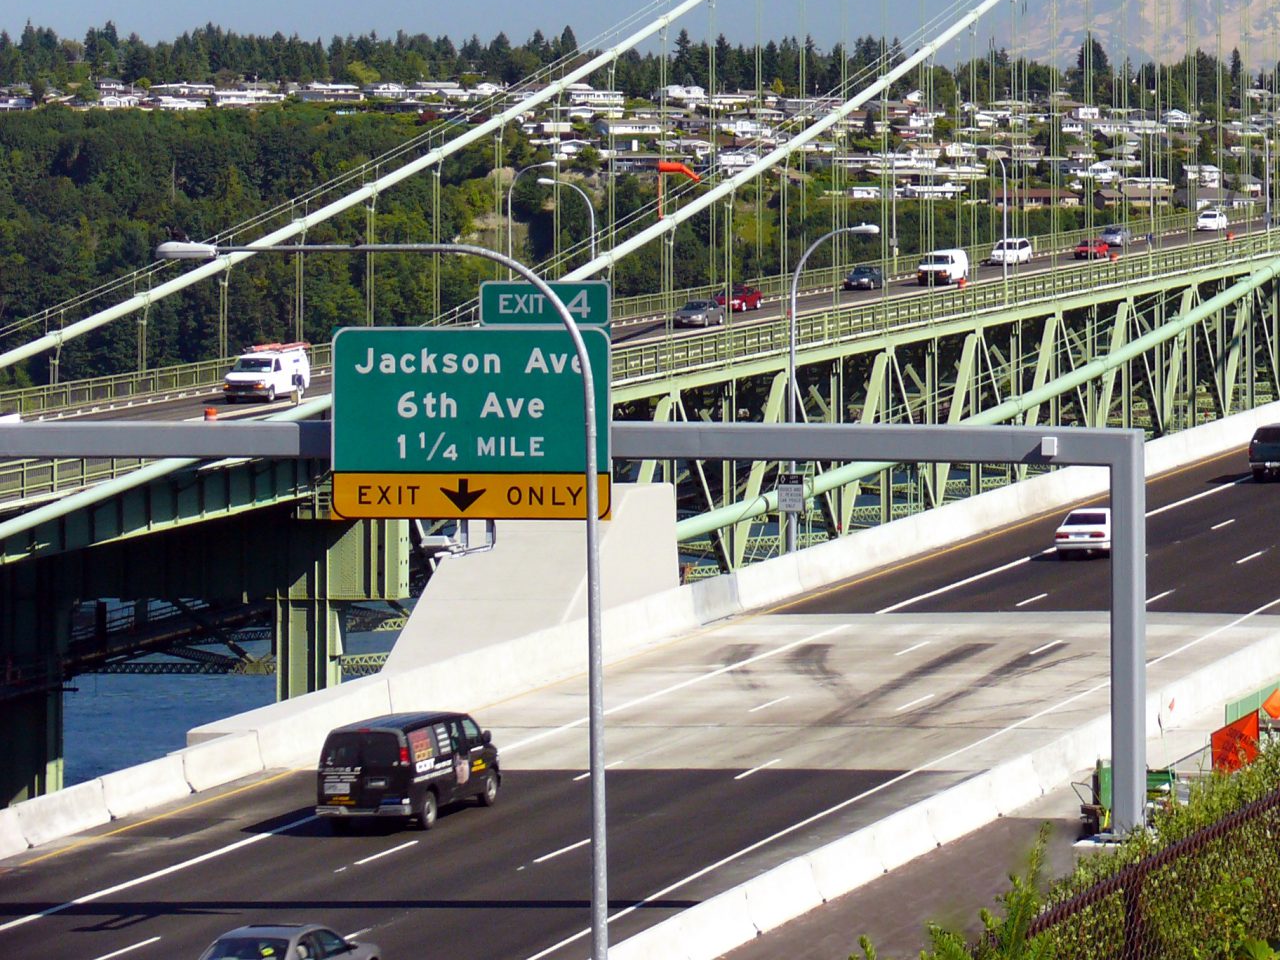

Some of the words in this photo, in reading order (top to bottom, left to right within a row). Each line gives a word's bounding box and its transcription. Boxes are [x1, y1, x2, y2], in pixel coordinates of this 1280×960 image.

[498, 293, 544, 314] EXIT
[566, 289, 591, 318] 4
[355, 347, 501, 374] Jackson
[524, 347, 581, 374] Ave
[397, 391, 458, 419] 6th
[480, 391, 545, 419] Ave
[477, 436, 545, 457] MILE
[357, 485, 421, 505] EXIT
[506, 486, 583, 506] ONLY
